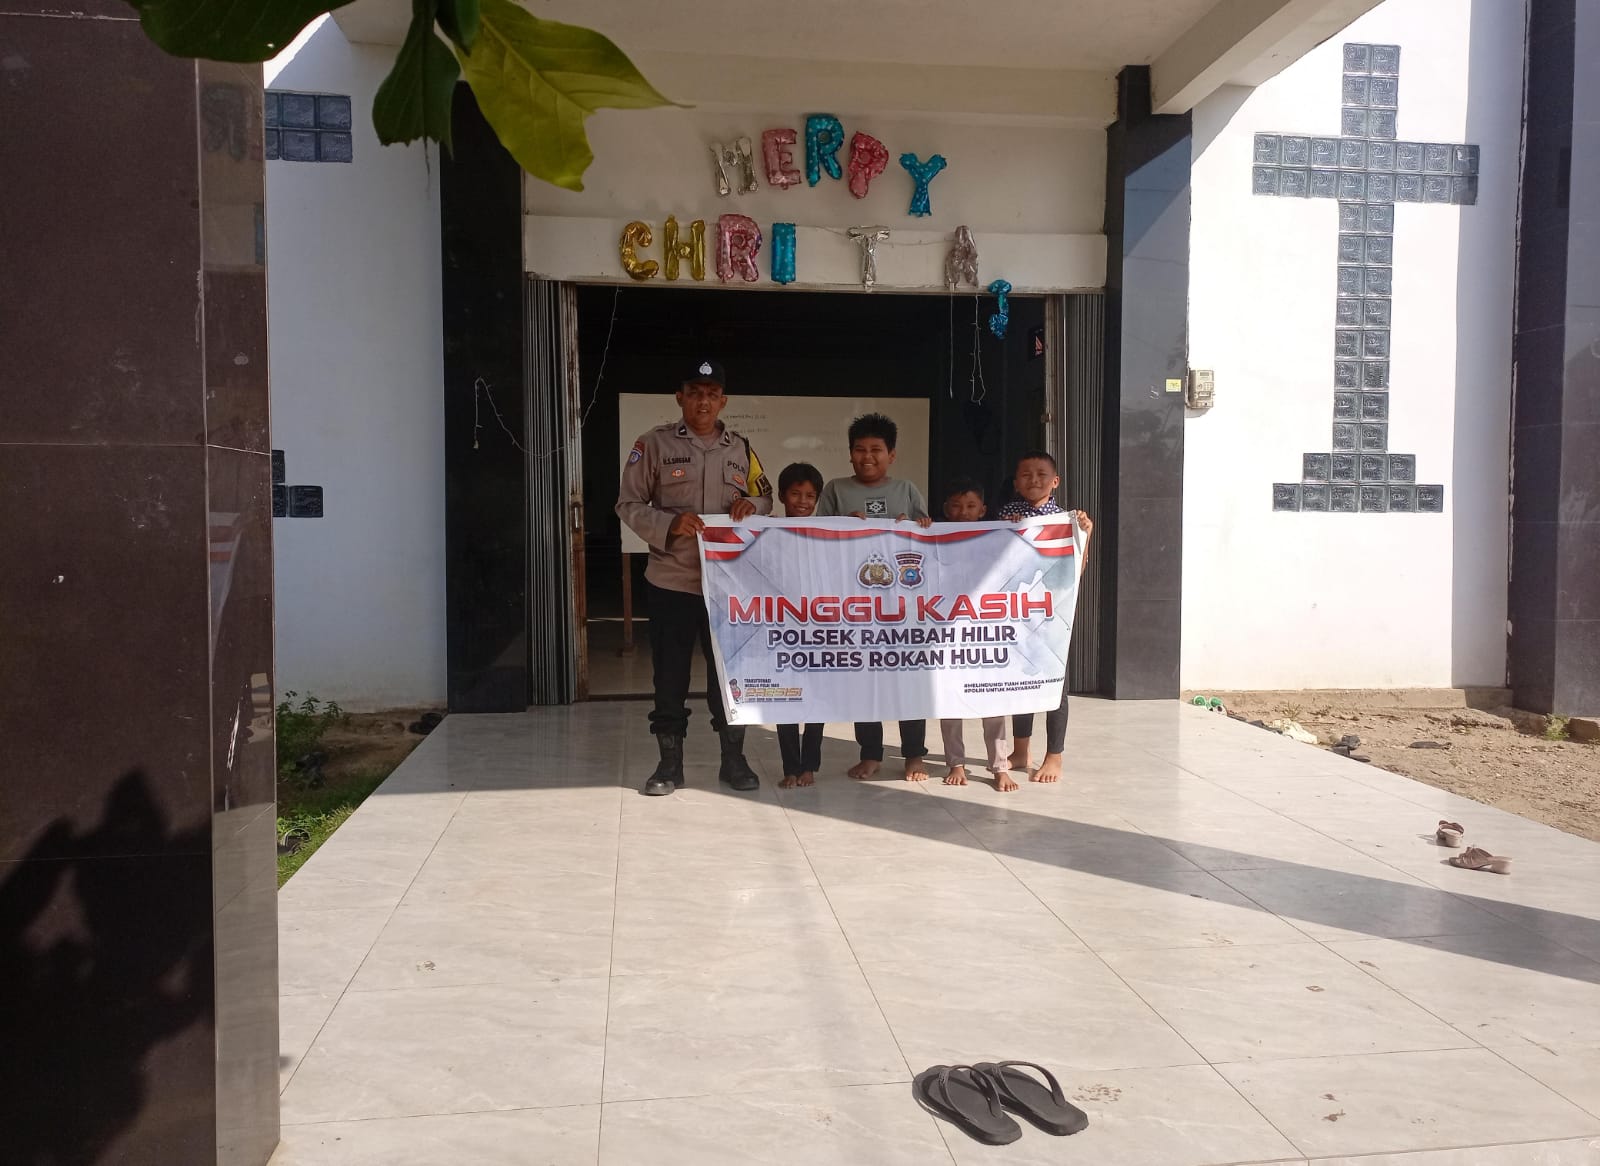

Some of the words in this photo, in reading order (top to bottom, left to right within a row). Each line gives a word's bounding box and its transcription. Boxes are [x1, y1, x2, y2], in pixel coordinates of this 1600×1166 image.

[729, 596, 906, 624] MINGGU
[916, 591, 1054, 622] KASIH
[767, 629, 856, 646] POLSEK
[860, 627, 955, 645] RAMBAH
[961, 625, 1017, 642] HILIR
[776, 651, 862, 668] POLRES
[868, 650, 944, 668] ROKAN
[950, 648, 1009, 665] HULU
[1005, 684, 1042, 692] MASYARAKAT
